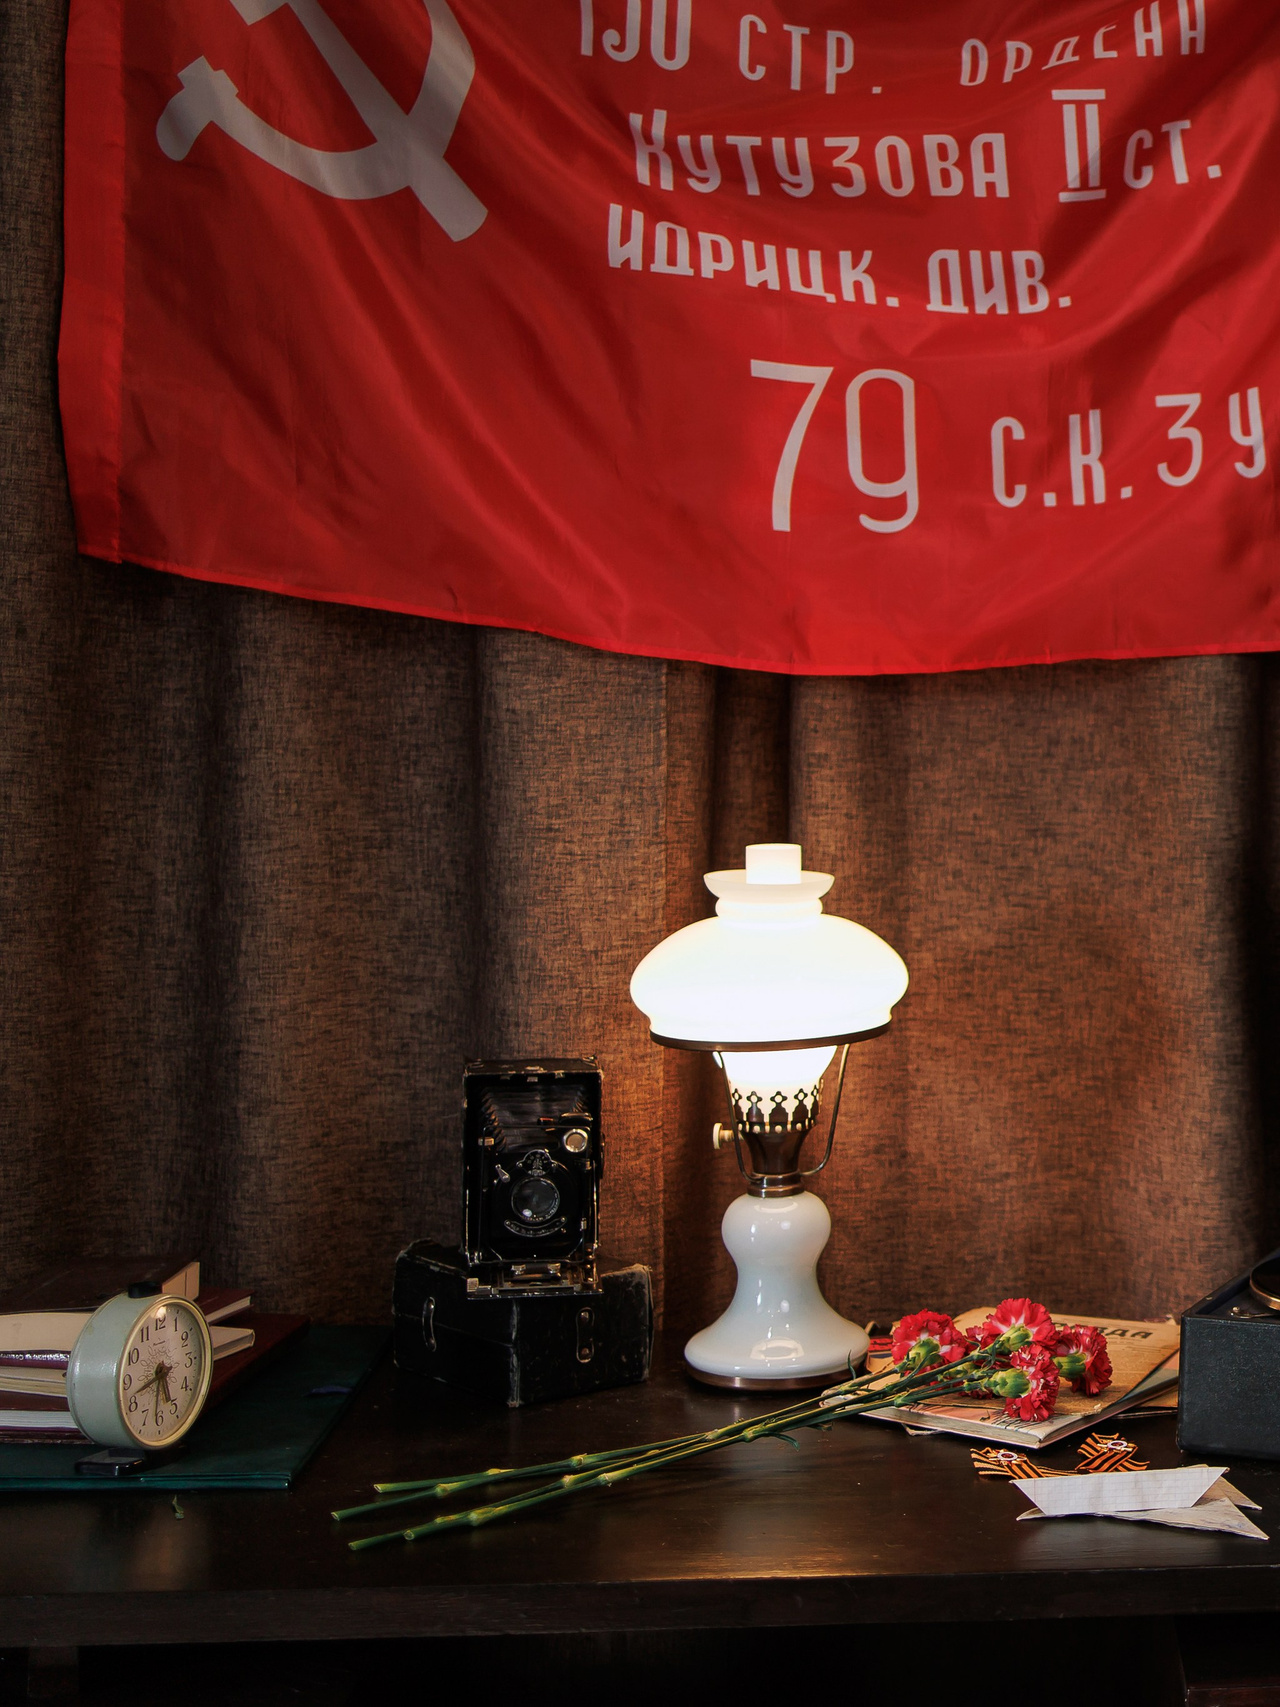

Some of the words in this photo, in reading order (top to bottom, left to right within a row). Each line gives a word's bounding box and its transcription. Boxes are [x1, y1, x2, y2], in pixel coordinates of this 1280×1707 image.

[739, 14, 881, 94] СТР.
[1052, 89, 1105, 202] II
[1126, 120, 1221, 188] СТ.
[608, 203, 899, 307] ИДРИЦК.
[927, 250, 1071, 314] ДИВ.
[751, 360, 919, 533] 79
[140, 1326, 150, 1342] 11
[181, 1331, 189, 1348] 2
[127, 1348, 140, 1366] 10
[184, 1352, 193, 1368] 3
[123, 1374, 132, 1391] 9
[180, 1376, 189, 1391] 4
[128, 1395, 138, 1413] 8
[141, 1409, 149, 1427] 7
[155, 1411, 164, 1427] 6
